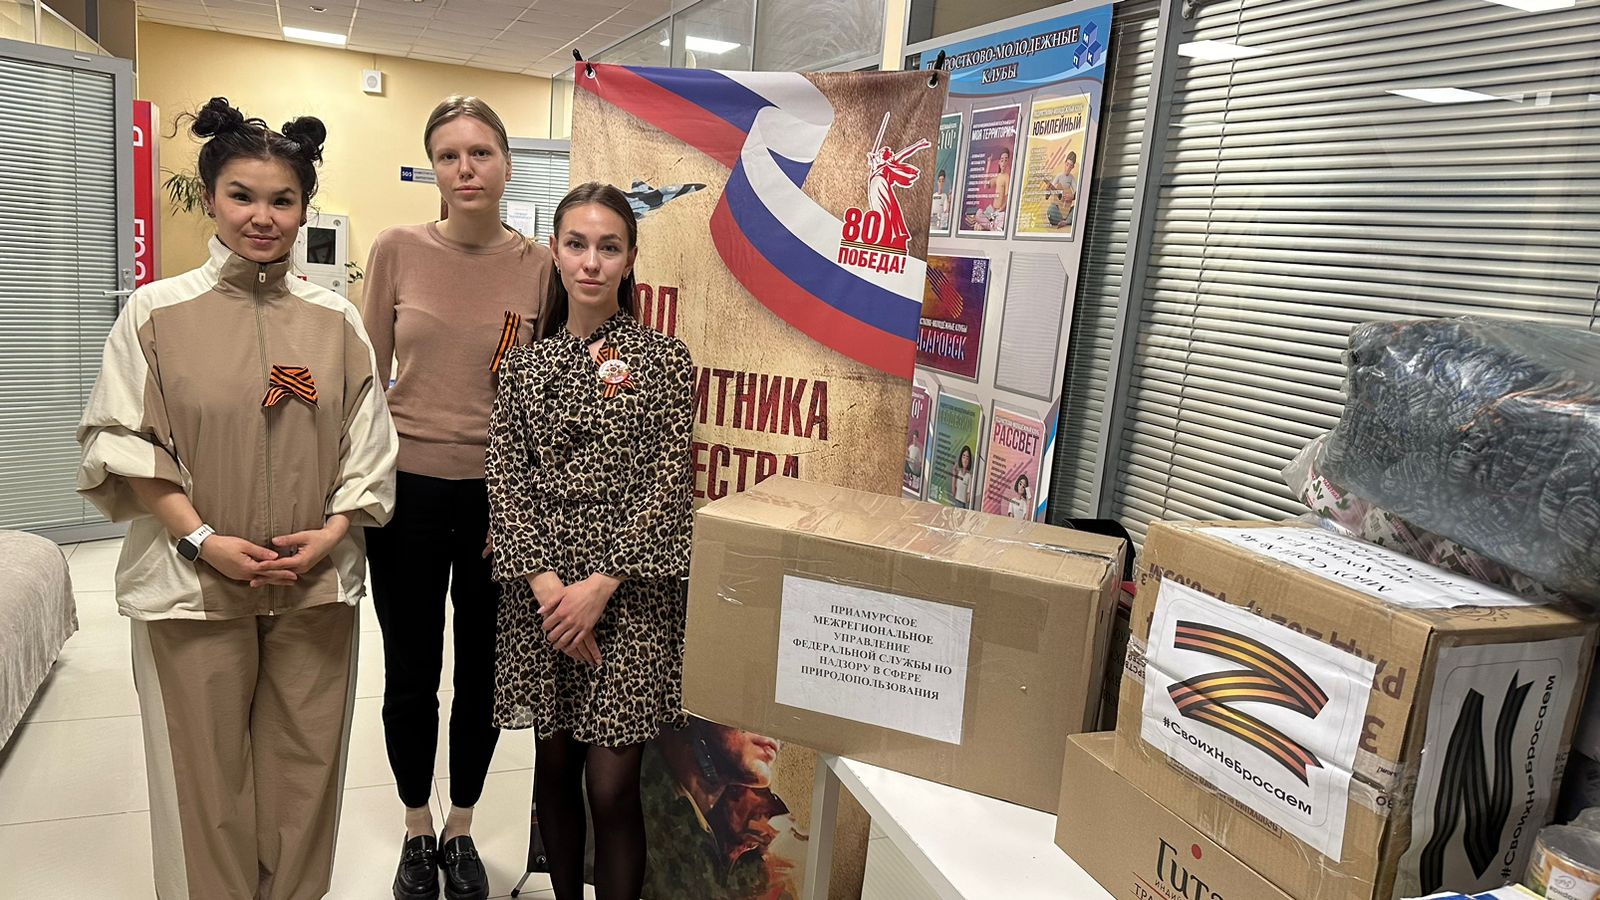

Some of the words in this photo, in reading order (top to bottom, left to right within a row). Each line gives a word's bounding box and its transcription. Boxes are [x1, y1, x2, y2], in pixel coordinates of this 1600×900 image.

[926, 28, 1079, 70] ПОРОСТКОВО-МОЛОДЕЖНЫЕ
[981, 63, 1018, 85] КЛУБЫ
[982, 125, 1018, 141] ТЕРРИТОРИЯ
[1032, 112, 1082, 137] ЮБИЛЕЙНЫЙ
[842, 207, 881, 244] 80
[838, 246, 907, 274] ПОБЕДА!
[993, 423, 1040, 457] РАССВЕТ
[813, 615, 934, 645] МЕЖРЕГИОНАЛЬНОЕ
[830, 604, 918, 628] ПРИАМУРСКОЕ
[792, 638, 876, 661] ФЕДЕРАЛЬНОЙ
[879, 654, 932, 672] СЛУЖБЫ
[934, 664, 953, 676] ПО
[834, 632, 911, 654] УПРАВЛЕНИЕ
[801, 665, 939, 700] ПРИРОДОПОЛЬЗОВАНИЯ
[819, 655, 871, 673] НАДЗОРУ
[873, 665, 880, 675] В
[882, 668, 922, 683] СФЕРЕ
[1162, 716, 1313, 816] #СвоихНеБросаем
[1500, 674, 1556, 879] #СвоихНеБросаем
